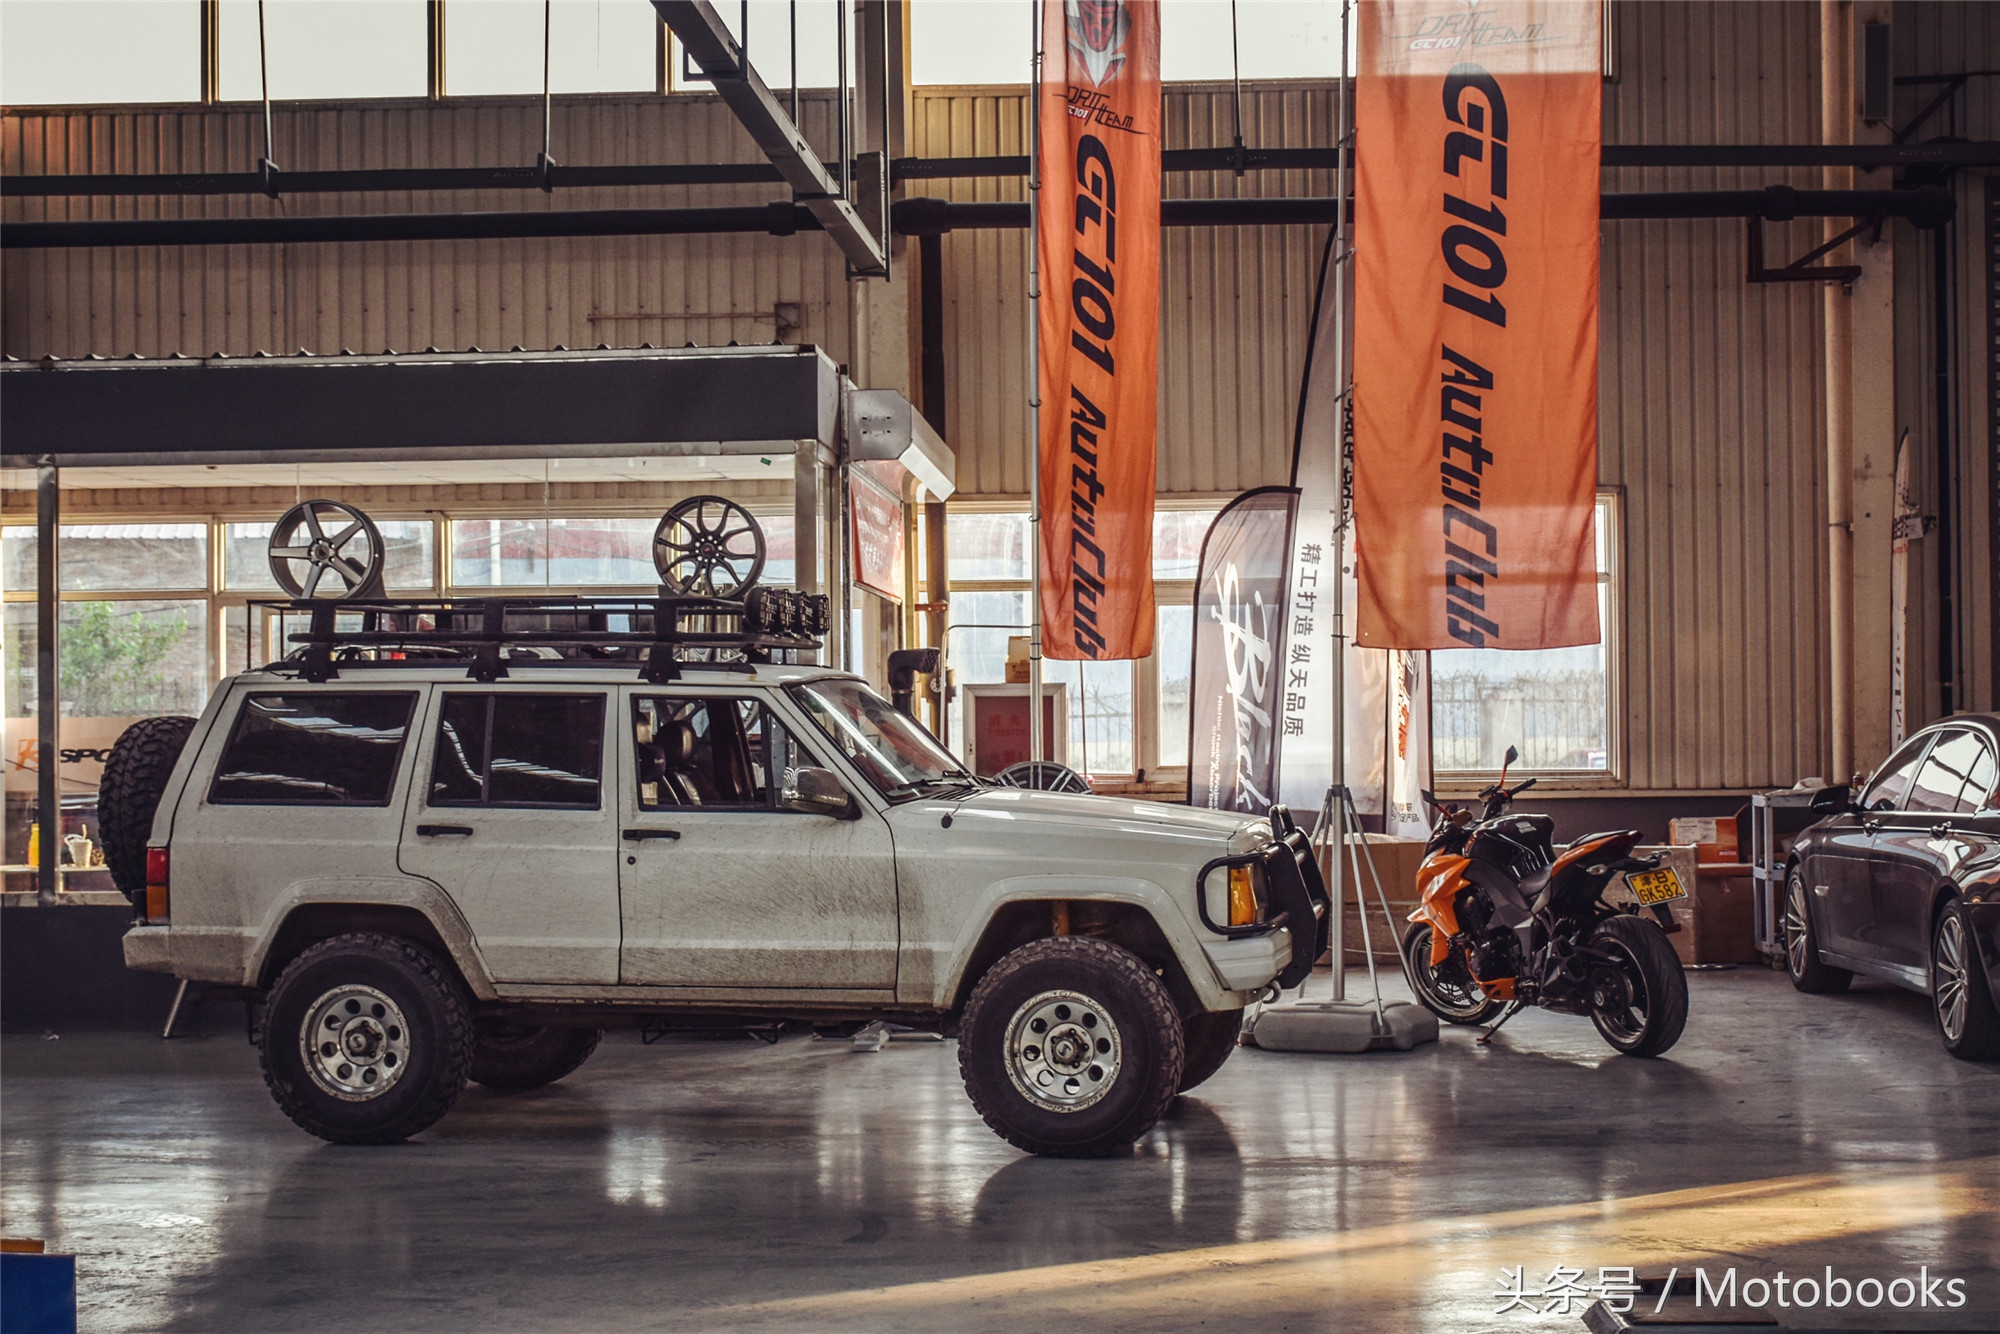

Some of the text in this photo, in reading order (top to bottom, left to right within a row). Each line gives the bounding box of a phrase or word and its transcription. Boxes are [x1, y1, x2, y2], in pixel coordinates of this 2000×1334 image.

[1284, 543, 1322, 737] 精工打造 纵天品质
[1639, 881, 1683, 902] GK582
